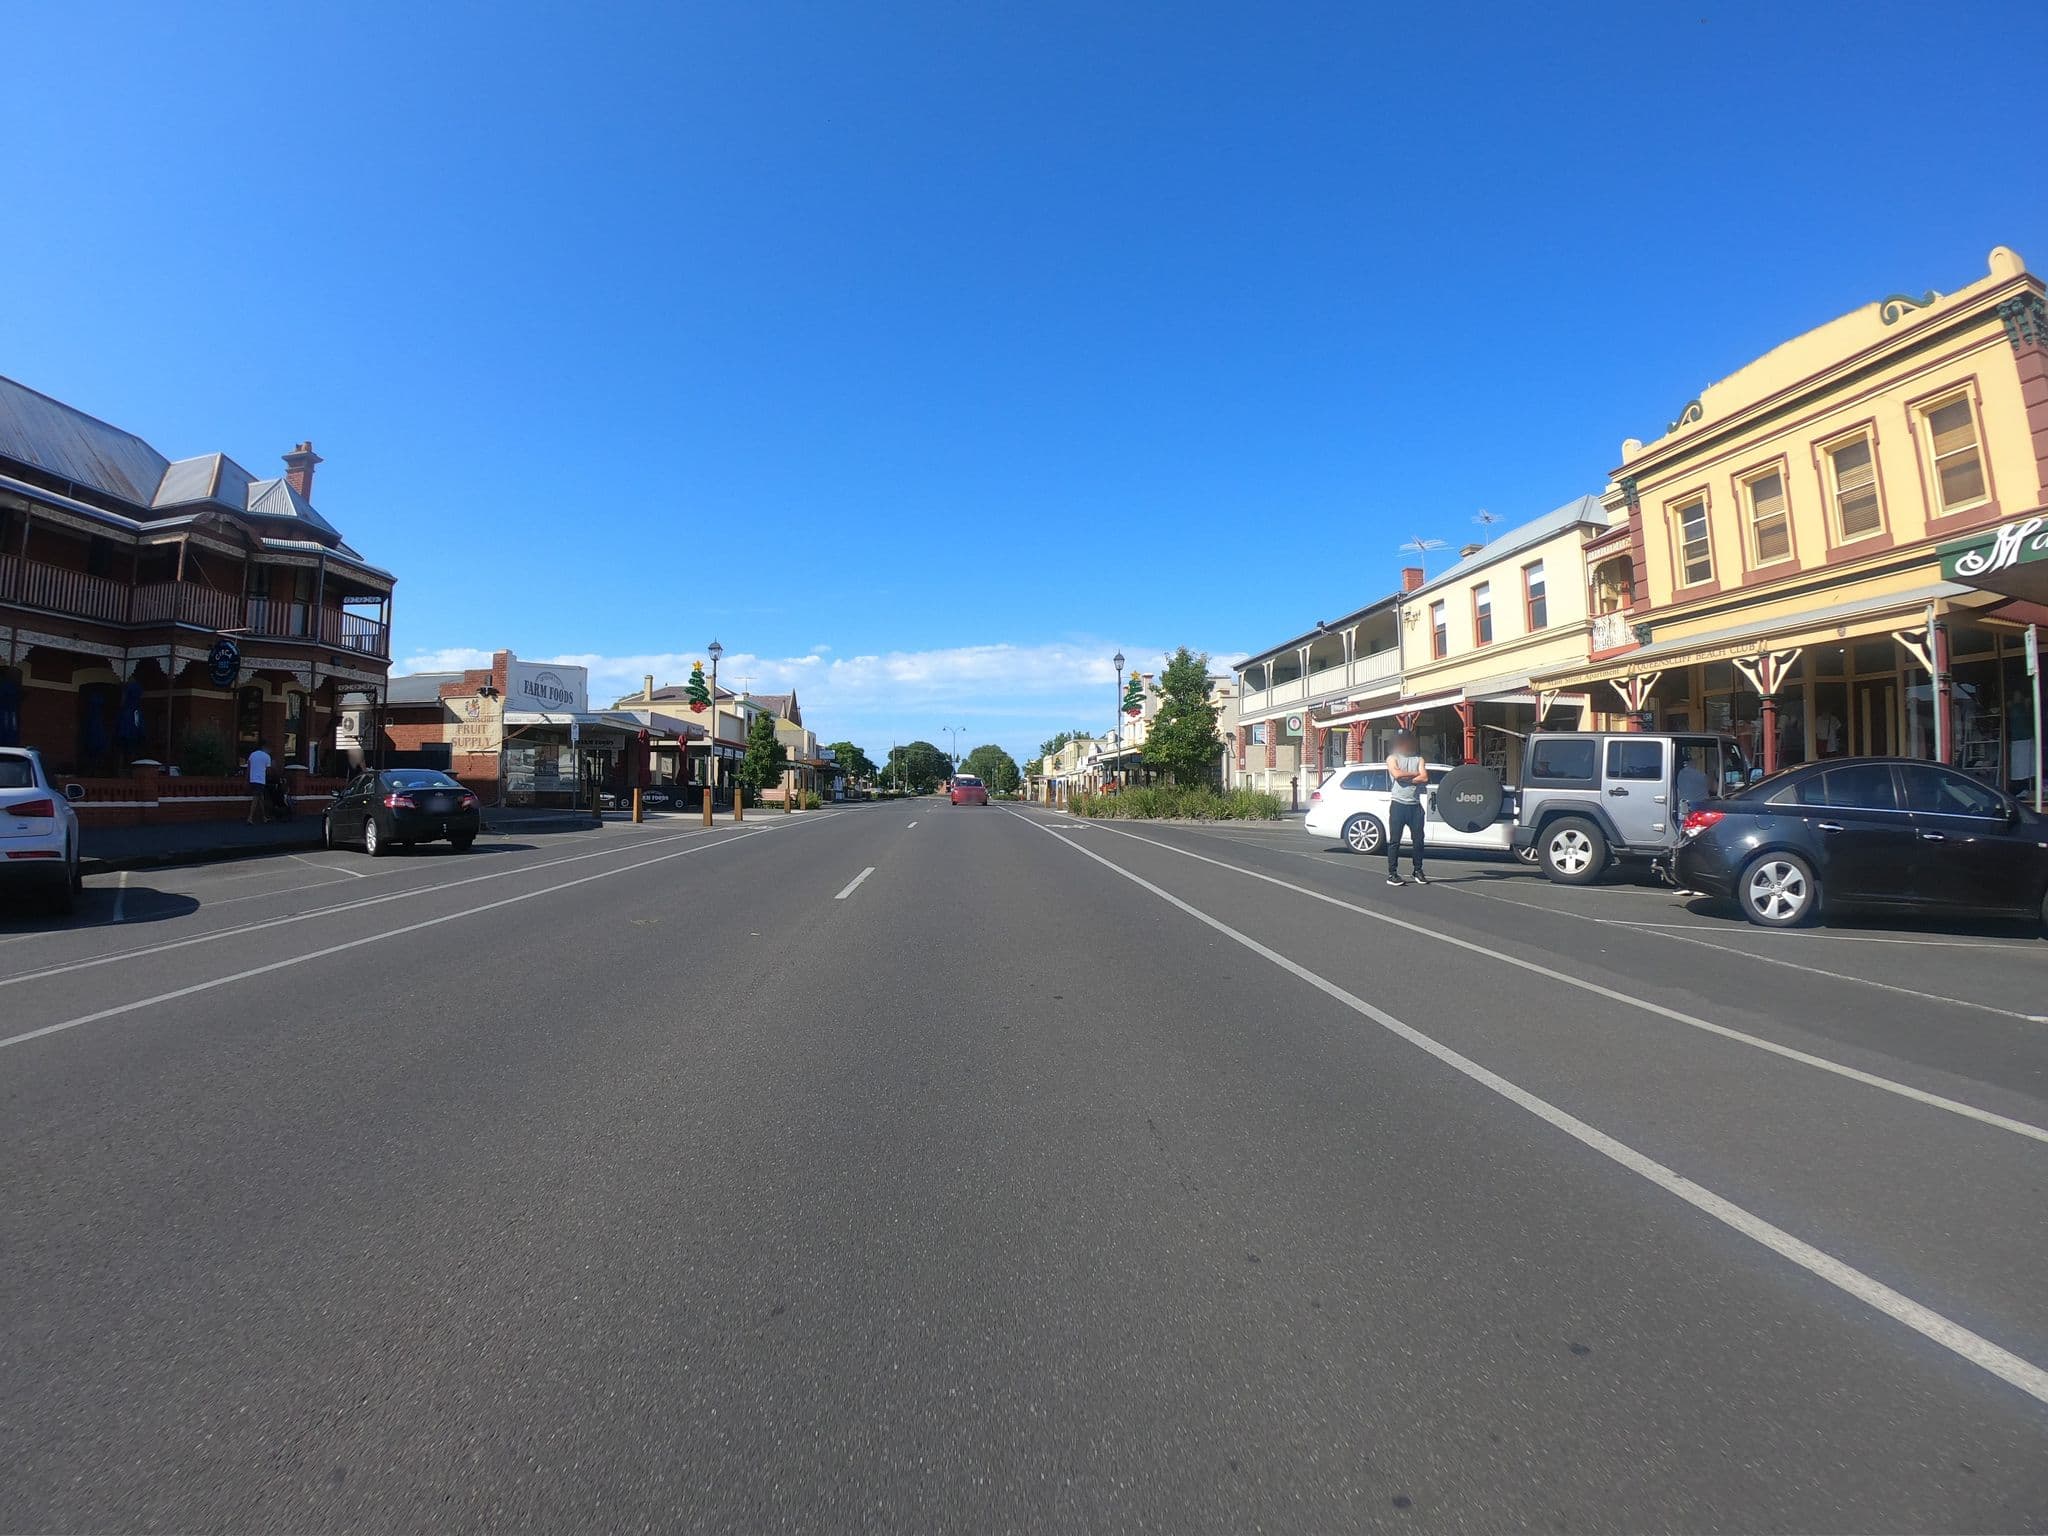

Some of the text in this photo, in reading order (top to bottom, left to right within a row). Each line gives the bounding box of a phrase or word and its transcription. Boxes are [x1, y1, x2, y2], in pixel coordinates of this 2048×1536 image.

[1637, 642, 1755, 671] QUEENSCLIFF BEACH CLUB
[523, 680, 547, 699] FARM
[549, 686, 574, 705] FOODS
[457, 724, 488, 735] FRUIT
[452, 736, 491, 748] SUPPLY
[1456, 791, 1484, 805] Jeep
